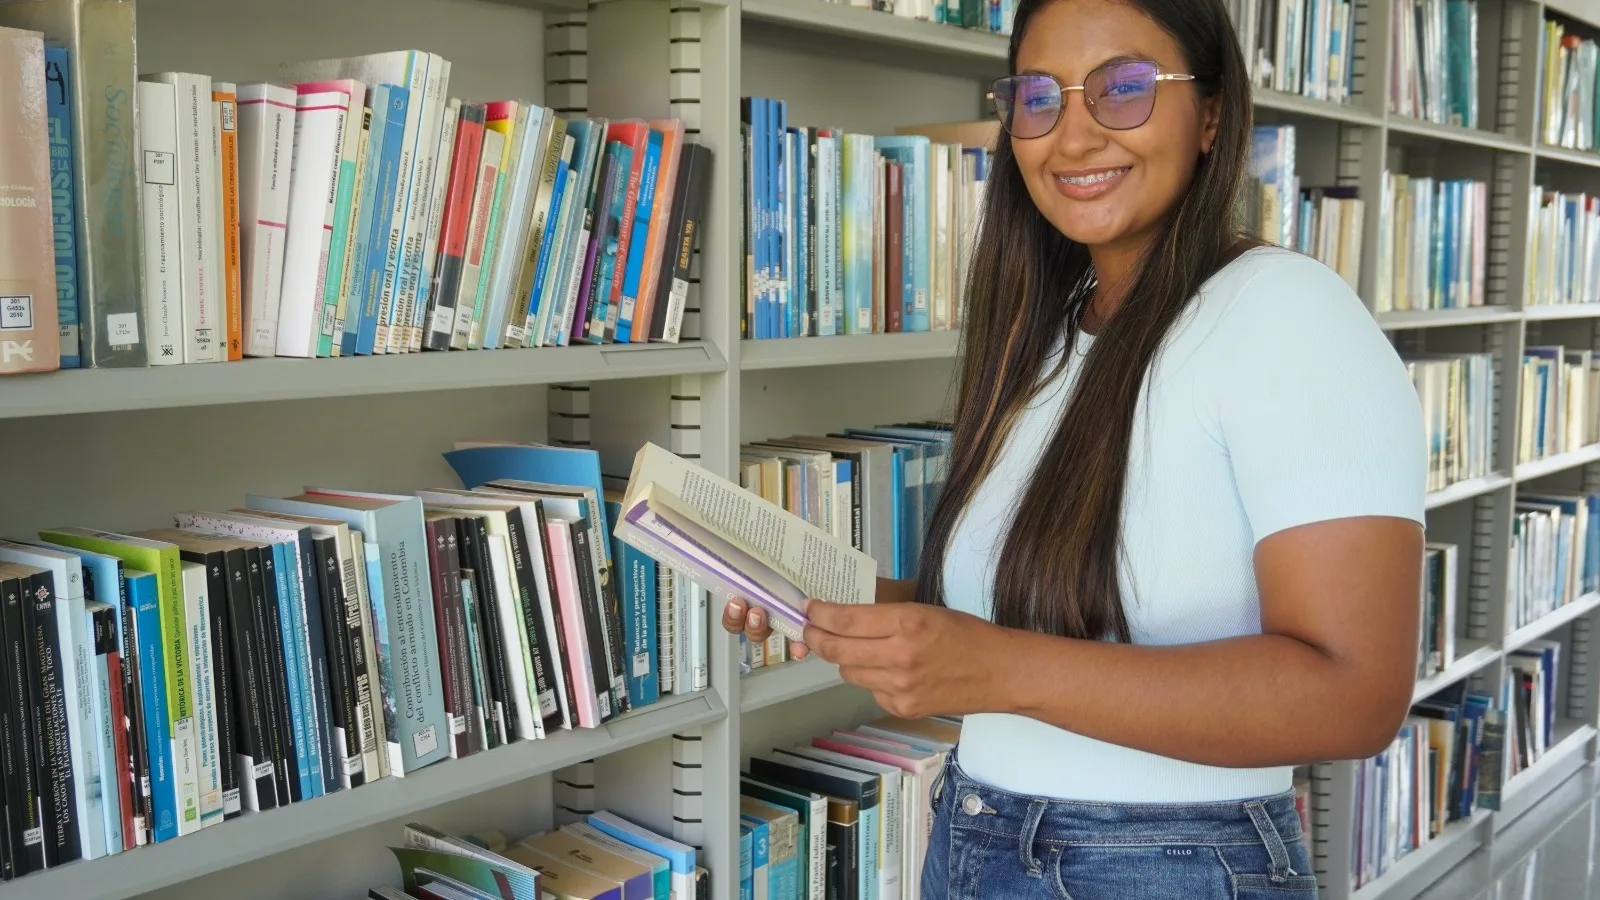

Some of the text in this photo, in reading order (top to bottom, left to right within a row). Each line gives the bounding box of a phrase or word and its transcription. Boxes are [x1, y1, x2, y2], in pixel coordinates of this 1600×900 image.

[630, 172, 638, 188] The
[390, 229, 398, 260] escrita
[404, 237, 413, 267] escrita
[681, 237, 689, 268] ¡BASTA
[613, 254, 622, 288] Society
[510, 524, 518, 550] CLAUDIA
[853, 507, 861, 550] Ambiental
[37, 602, 51, 610] CNMH
[392, 553, 404, 631] entendimiento
[293, 597, 301, 627] discusión
[399, 542, 424, 722] del conflicto armado en Colombia
[38, 626, 47, 672] MAGDALENA
[533, 655, 545, 678] AHORA
[50, 683, 55, 692] DE
[400, 648, 413, 718] Contribución
[52, 696, 61, 754] PARCELACIONES
[52, 768, 58, 778] EN
[758, 838, 766, 855] 3
